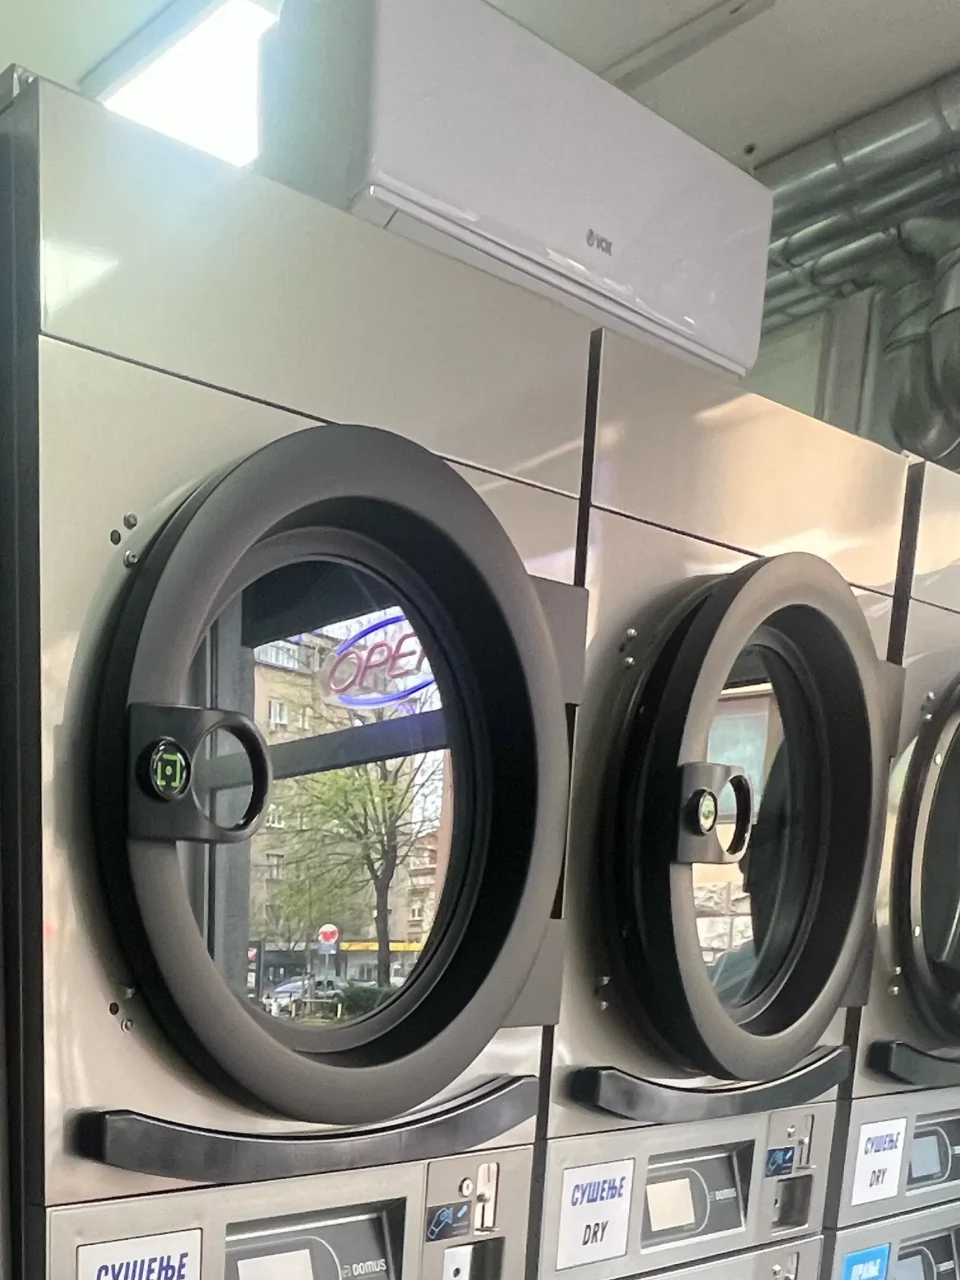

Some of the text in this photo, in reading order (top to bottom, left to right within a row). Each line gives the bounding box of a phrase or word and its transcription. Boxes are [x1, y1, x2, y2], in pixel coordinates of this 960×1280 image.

[571, 1176, 626, 1207] СУШЕЊЕ
[582, 1220, 609, 1246] DRY
[352, 1258, 387, 1278] DOMUS
